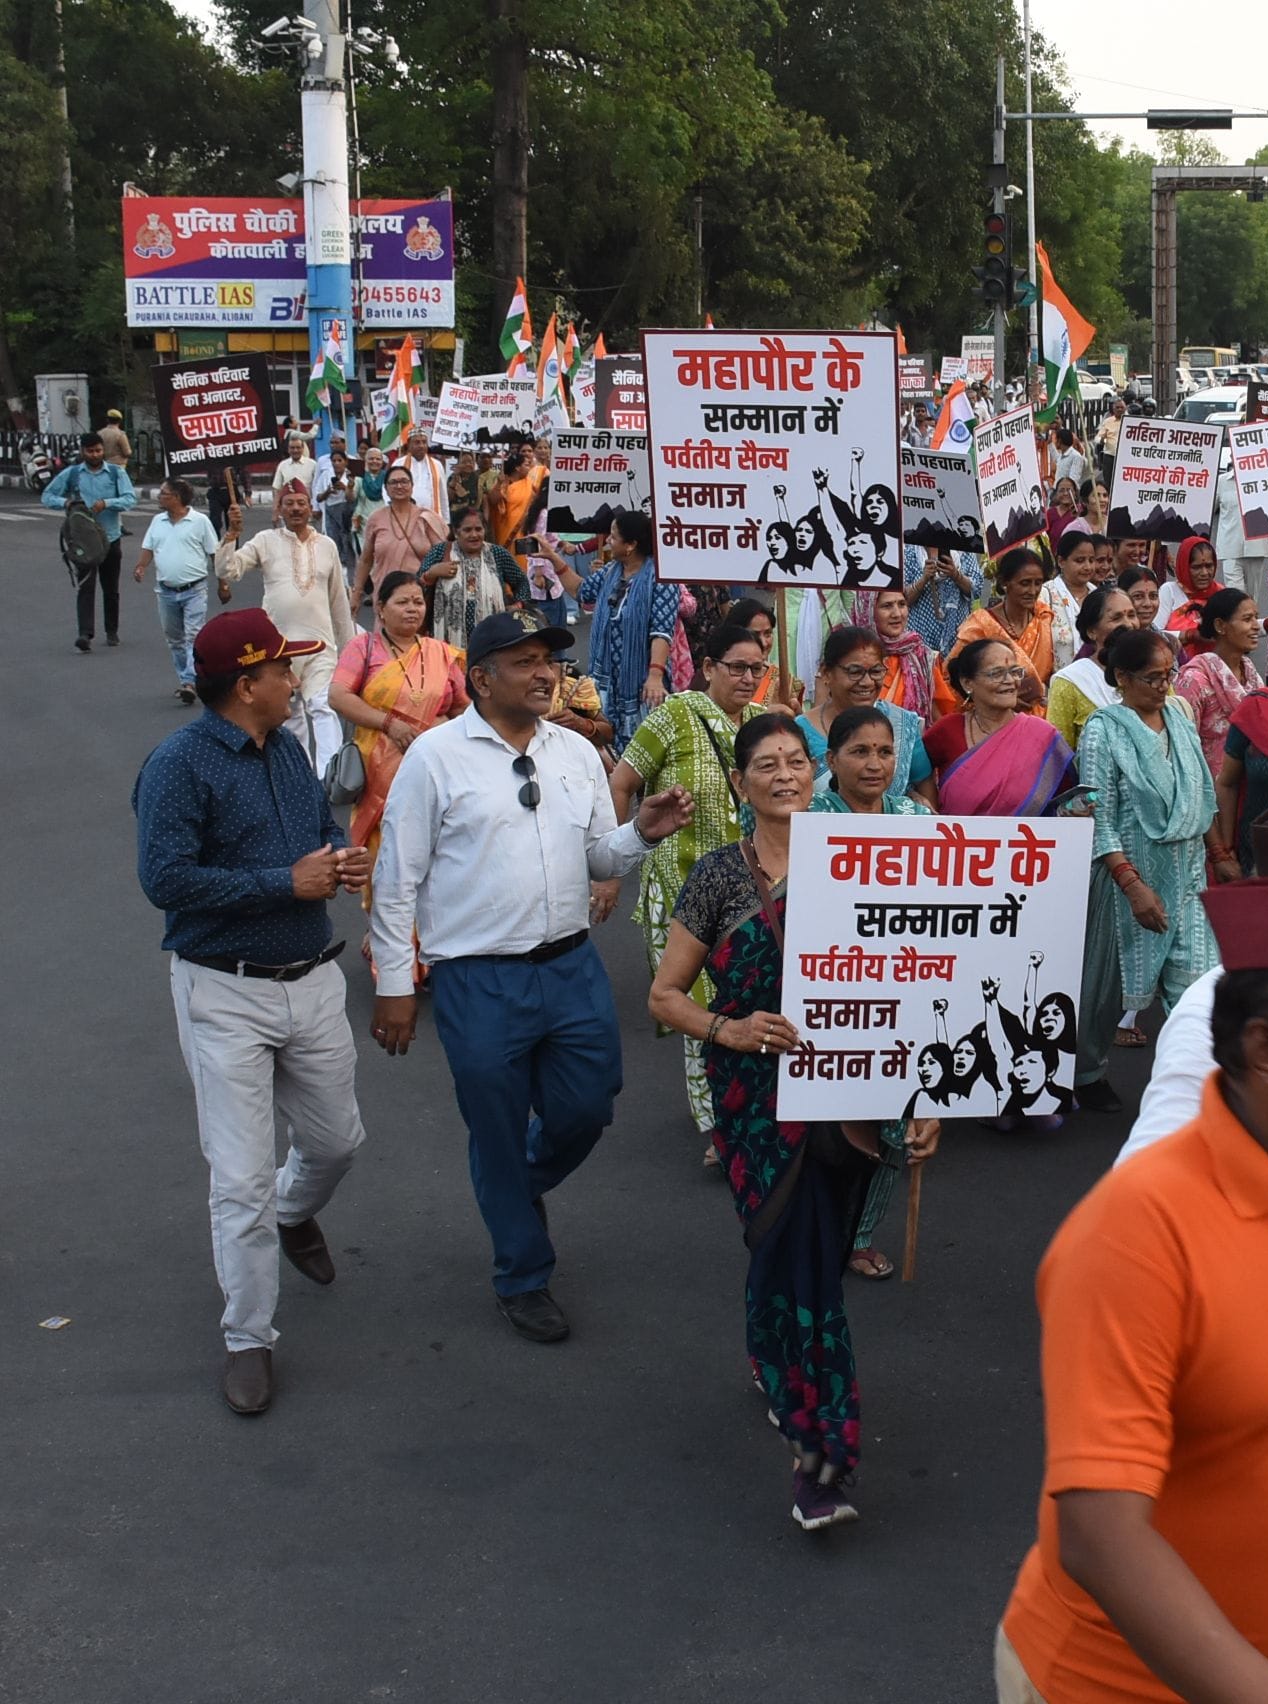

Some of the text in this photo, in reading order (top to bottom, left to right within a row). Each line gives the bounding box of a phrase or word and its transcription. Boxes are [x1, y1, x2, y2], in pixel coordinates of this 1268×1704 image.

[173, 208, 236, 238] पुलिस
[243, 207, 298, 233] चौकी
[208, 239, 288, 259] कोतवाली
[135, 286, 215, 305] BATTLE
[219, 286, 253, 305] IAS
[135, 312, 171, 322] PURANIA
[366, 307, 428, 319] Battle IAS
[673, 337, 864, 392] महापौर के
[170, 367, 250, 390] सैनिक परिवार
[499, 379, 509, 390] की
[182, 388, 246, 407] का अनादर,
[449, 387, 480, 402] महापौ
[619, 391, 633, 404] का
[178, 406, 257, 440] सपा का
[611, 410, 647, 430] सप
[701, 397, 844, 435] सम्मान में
[556, 431, 648, 451] सपा की पहच
[977, 413, 1033, 453] सपा की पहचान,
[1126, 422, 1217, 448] महिला आरक्षण
[1233, 429, 1264, 448] सपा
[170, 437, 277, 464] असली चेहरा उजागर।
[661, 438, 789, 471] पर्वतीय सैन्य
[1131, 445, 1203, 465] पर घटिया राजनीति,
[555, 453, 630, 472] नारी शक्ति
[917, 454, 971, 475] पहचान,
[979, 445, 1016, 480] नारी शक्ति
[554, 481, 622, 494] का अपमान
[904, 471, 936, 489] शक्ति
[1122, 465, 1209, 488] सपाइयों की रही
[1241, 479, 1258, 495] का
[668, 483, 747, 509] समाज
[902, 496, 935, 510] पमान
[982, 479, 1018, 507] का अपमान
[1137, 488, 1186, 504] पुरानी निति
[660, 516, 762, 551] मैदान में
[827, 823, 1056, 887] महापौर के
[854, 893, 1027, 938] सम्मान में
[799, 945, 957, 983] पर्वतीय सैन्य
[803, 999, 901, 1030] समाज
[786, 1040, 915, 1081] मैदान में
